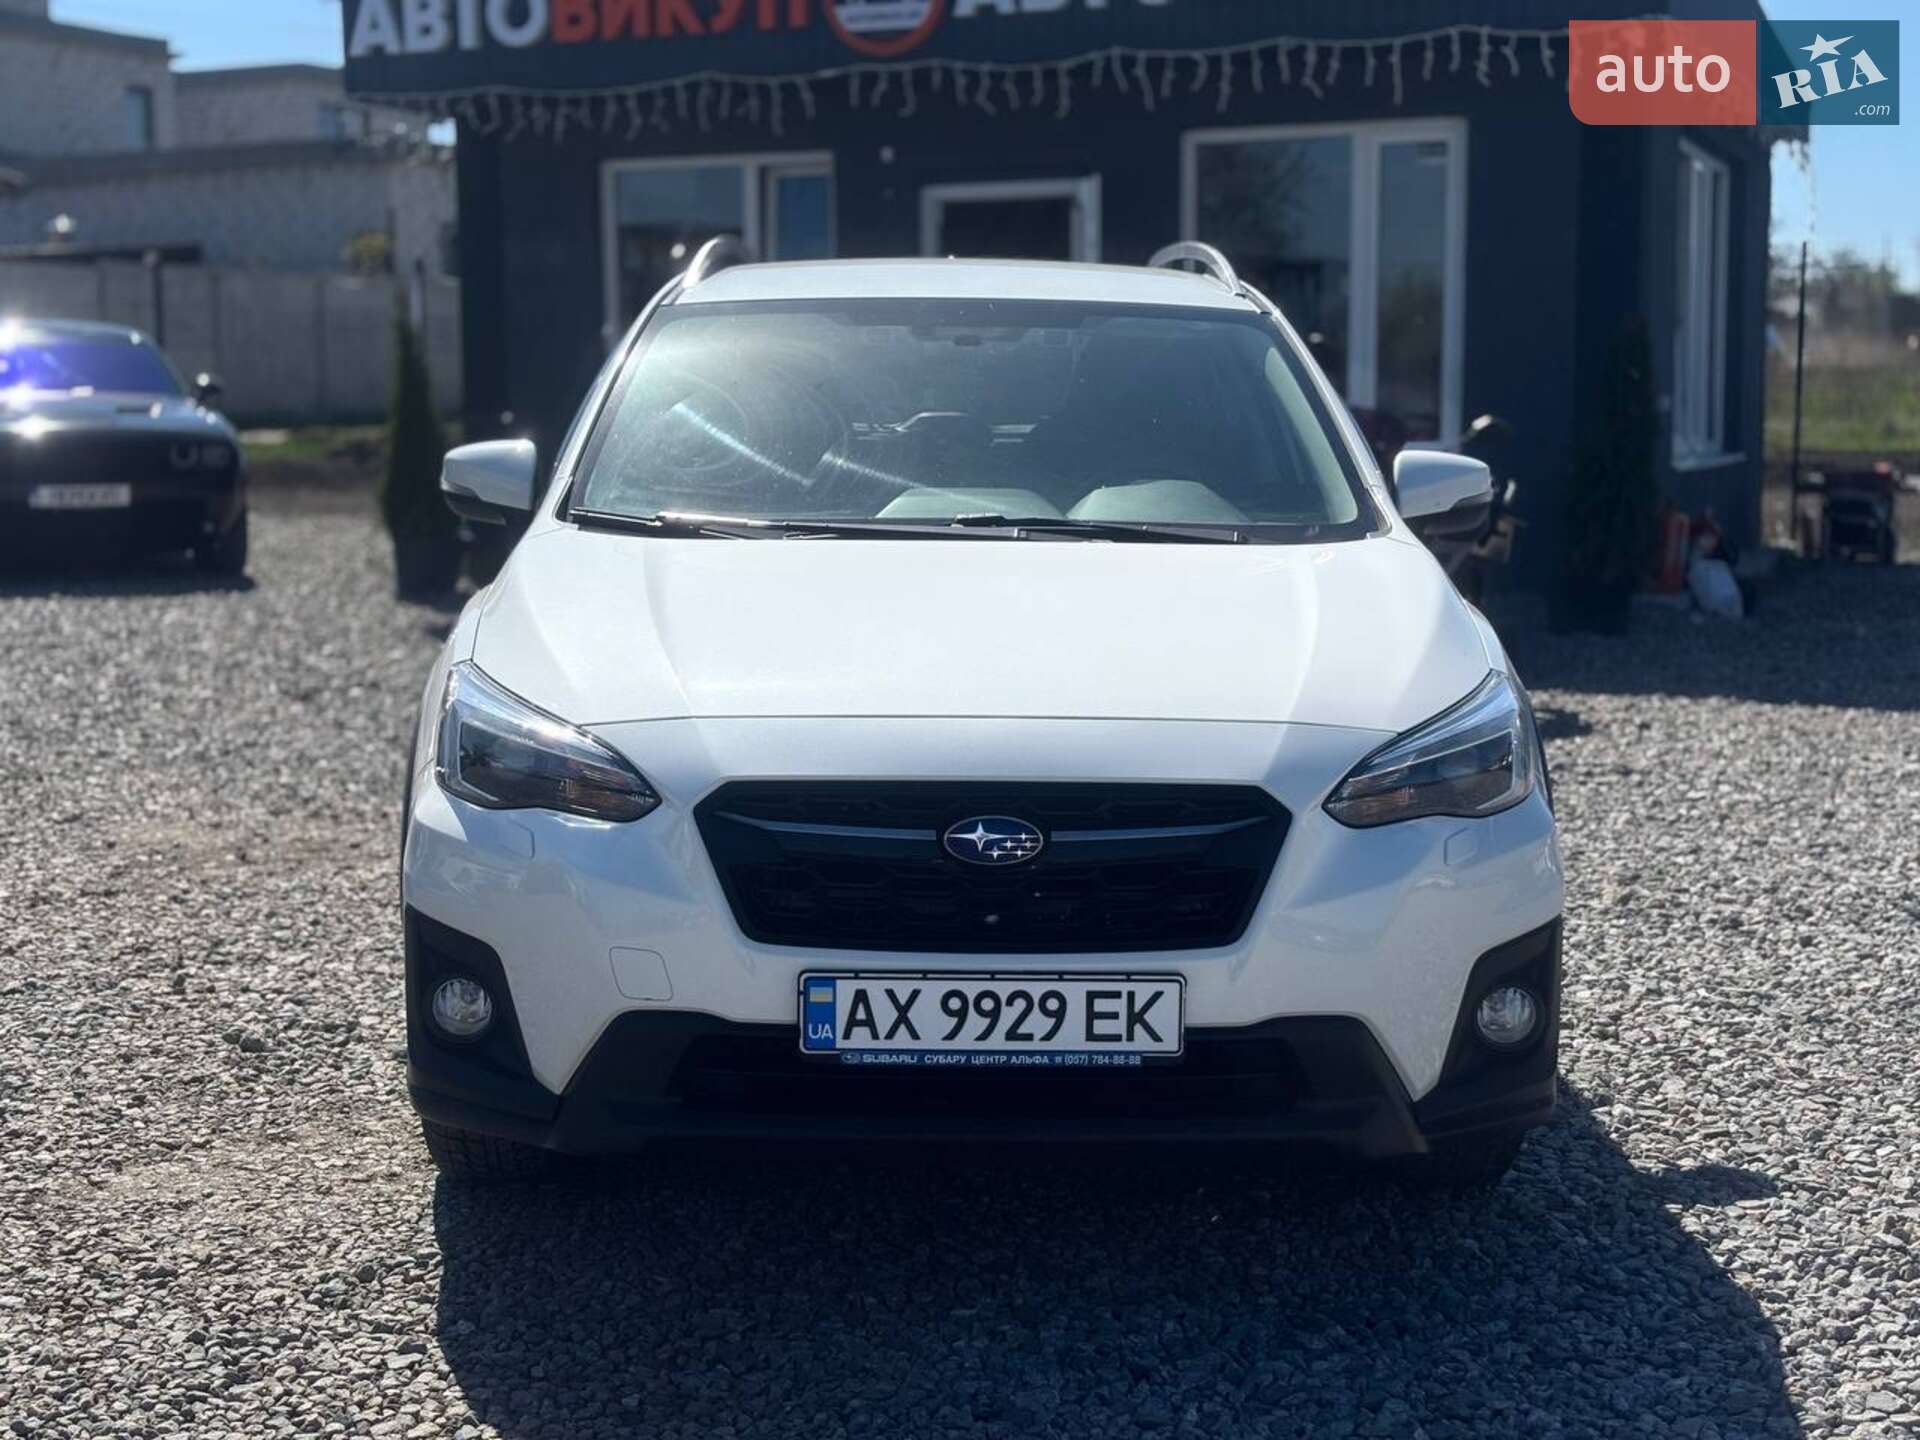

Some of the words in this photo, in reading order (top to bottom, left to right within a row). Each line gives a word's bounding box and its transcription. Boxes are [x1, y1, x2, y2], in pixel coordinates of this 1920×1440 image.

[841, 988, 922, 1041] AX
[940, 989, 1068, 1042] 9929
[1085, 990, 1165, 1043] EK
[808, 1023, 834, 1040] UA
[862, 1054, 918, 1064] SUBARU
[924, 1054, 967, 1064] СУБАРУ
[971, 1055, 1008, 1066] ЦЕНТР
[1010, 1055, 1049, 1065] АЛЬФА
